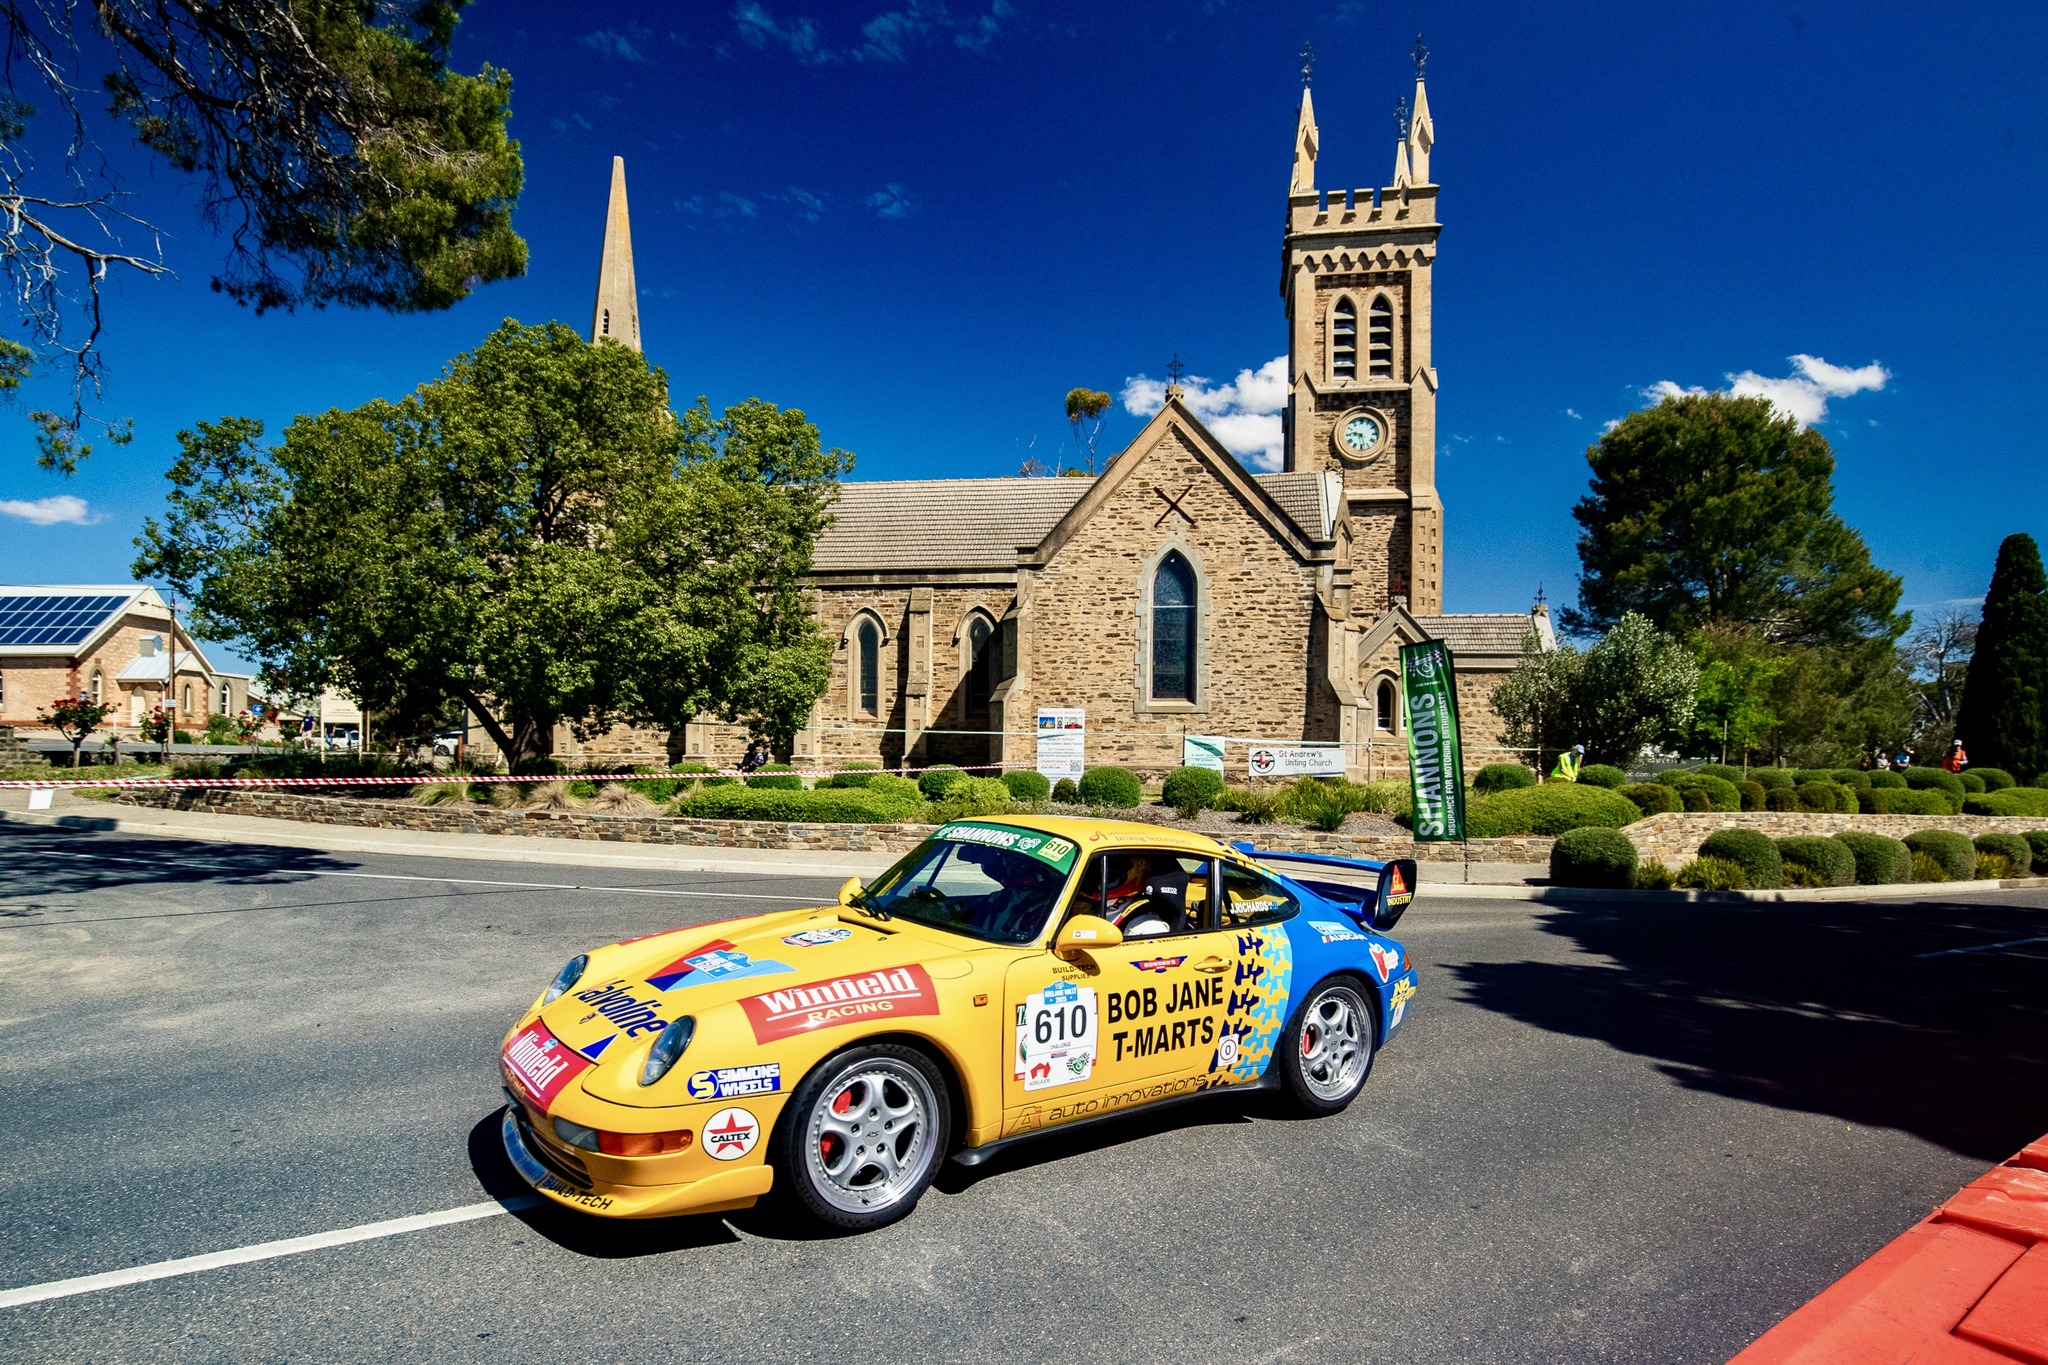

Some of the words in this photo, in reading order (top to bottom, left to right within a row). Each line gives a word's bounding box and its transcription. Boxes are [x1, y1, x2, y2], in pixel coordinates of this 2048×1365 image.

[1438, 690, 1450, 741] ENTHUSIASTS
[1285, 759, 1307, 768] Uniting
[1308, 759, 1333, 767] Church
[1410, 693, 1445, 836] SHANNONS
[1442, 741, 1454, 782] MOTORING
[1444, 781, 1455, 798] FOR
[1446, 798, 1457, 836] INSURANCE
[946, 826, 1021, 847] SHANNONS
[1045, 841, 1069, 855] 610
[1392, 873, 1405, 892] Sika
[1229, 901, 1269, 915] J.RICHARDS
[1386, 894, 1413, 907] INDUSTRY
[1052, 963, 1097, 974] BUILD-TECH
[1143, 959, 1176, 968] BOWDEN'S
[1061, 973, 1091, 981] SUPPLIES
[1393, 976, 1410, 997] NO
[754, 968, 919, 1014] Winfield
[1107, 987, 1158, 1025] BOB
[1165, 976, 1223, 1014] JANE
[572, 978, 670, 1039] Valvoline
[807, 1000, 894, 1022] RACING
[1035, 1004, 1087, 1044] 610
[1050, 1042, 1071, 1050] CHALLENGE
[1112, 1015, 1214, 1062] T-MARTS
[507, 1030, 570, 1091] Winfield
[717, 1063, 780, 1083] SIMMONS
[1029, 1078, 1050, 1086] ADELAIDE
[720, 1078, 773, 1097] WHEELS
[1049, 1099, 1098, 1121] auto
[1102, 1074, 1207, 1110] innovations
[710, 1131, 751, 1143] CALTEX
[543, 1175, 613, 1210] BUILD-TECH
